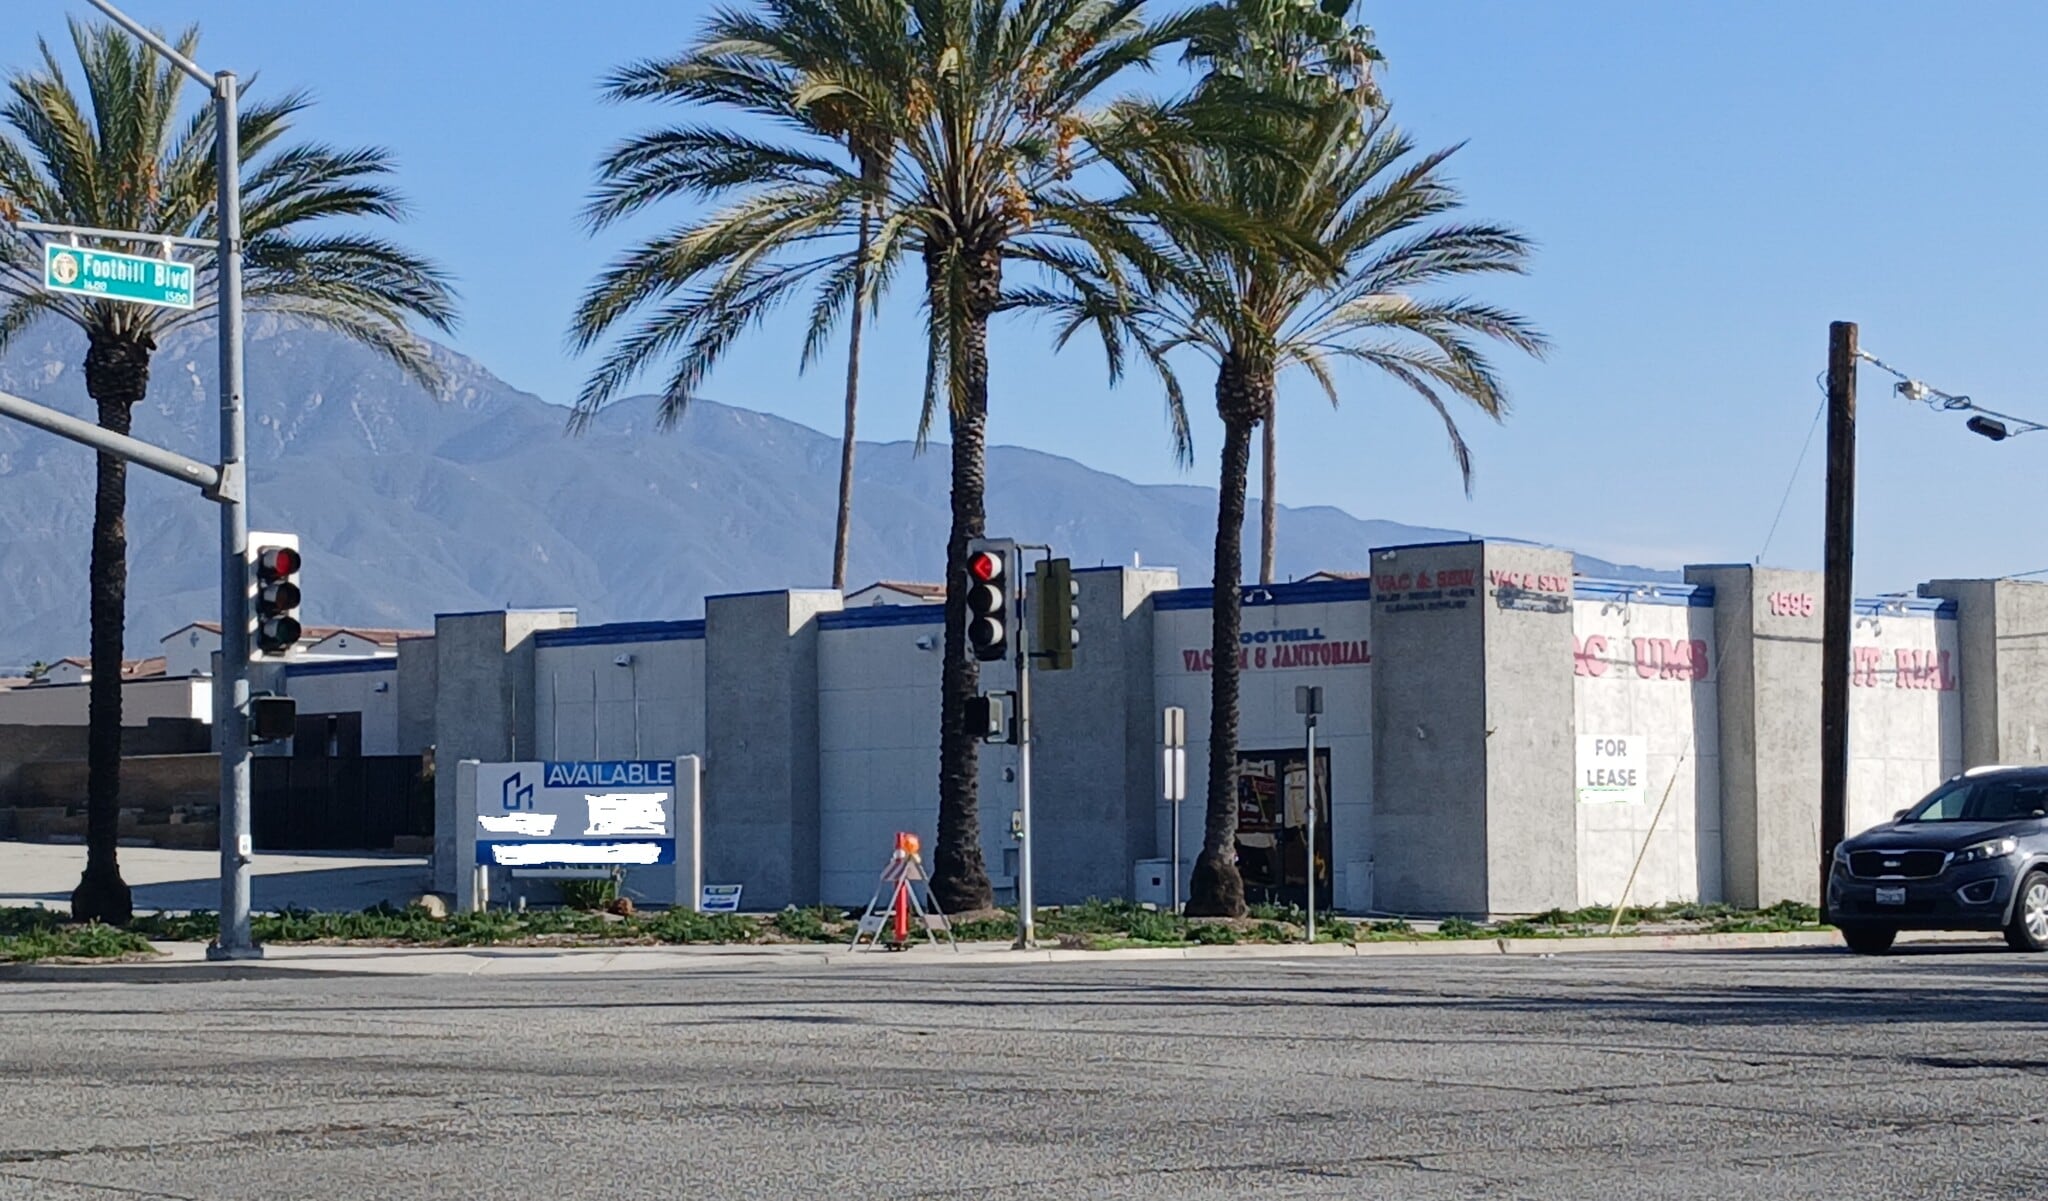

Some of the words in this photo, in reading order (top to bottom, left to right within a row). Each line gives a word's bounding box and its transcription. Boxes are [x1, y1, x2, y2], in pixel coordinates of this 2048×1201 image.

[83, 254, 145, 283] Foothill
[155, 264, 189, 289] Blvd
[165, 290, 188, 303] 1500
[1767, 591, 1815, 618] 1595
[1238, 627, 1326, 644] OOTHILL
[1272, 640, 1371, 667] JANITORIAL
[1595, 739, 1627, 756] FOR
[547, 762, 672, 785] AVAILABLE
[1586, 769, 1637, 786] LEASE
